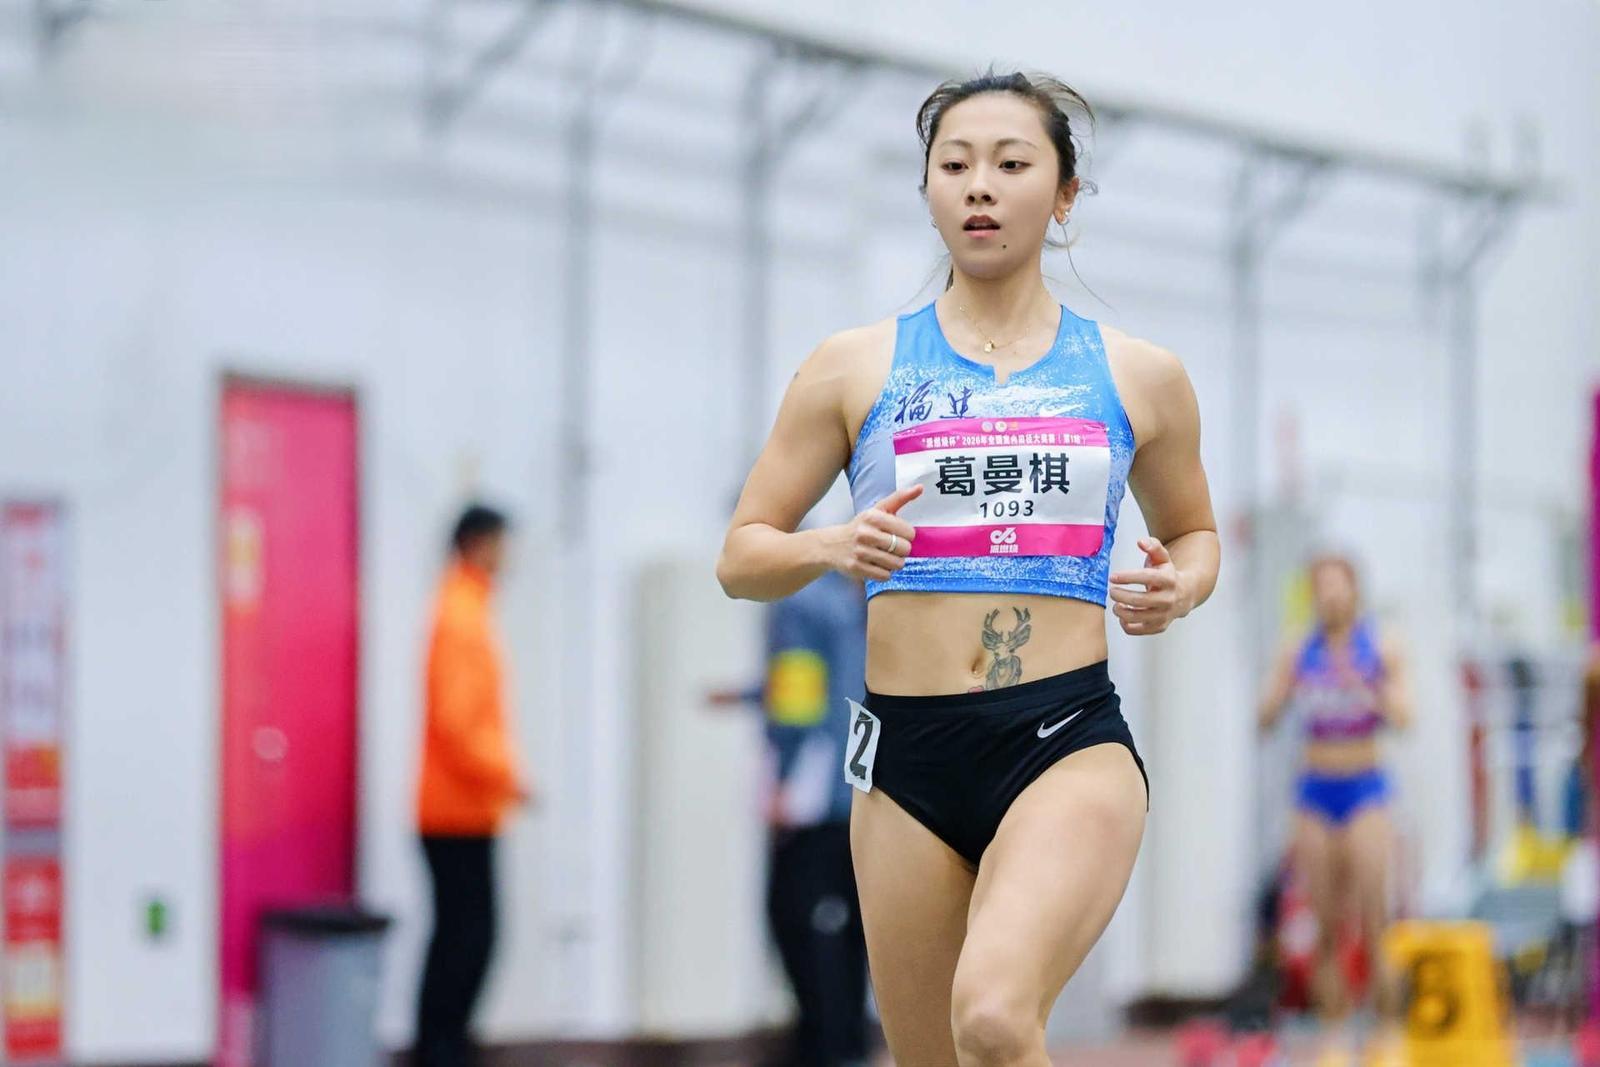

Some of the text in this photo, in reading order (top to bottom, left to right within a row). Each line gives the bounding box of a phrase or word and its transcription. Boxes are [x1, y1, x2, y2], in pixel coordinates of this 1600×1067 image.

[934, 453, 1070, 496] 葛曼棋
[979, 500, 1034, 518] 1093
[850, 711, 873, 780] 2
